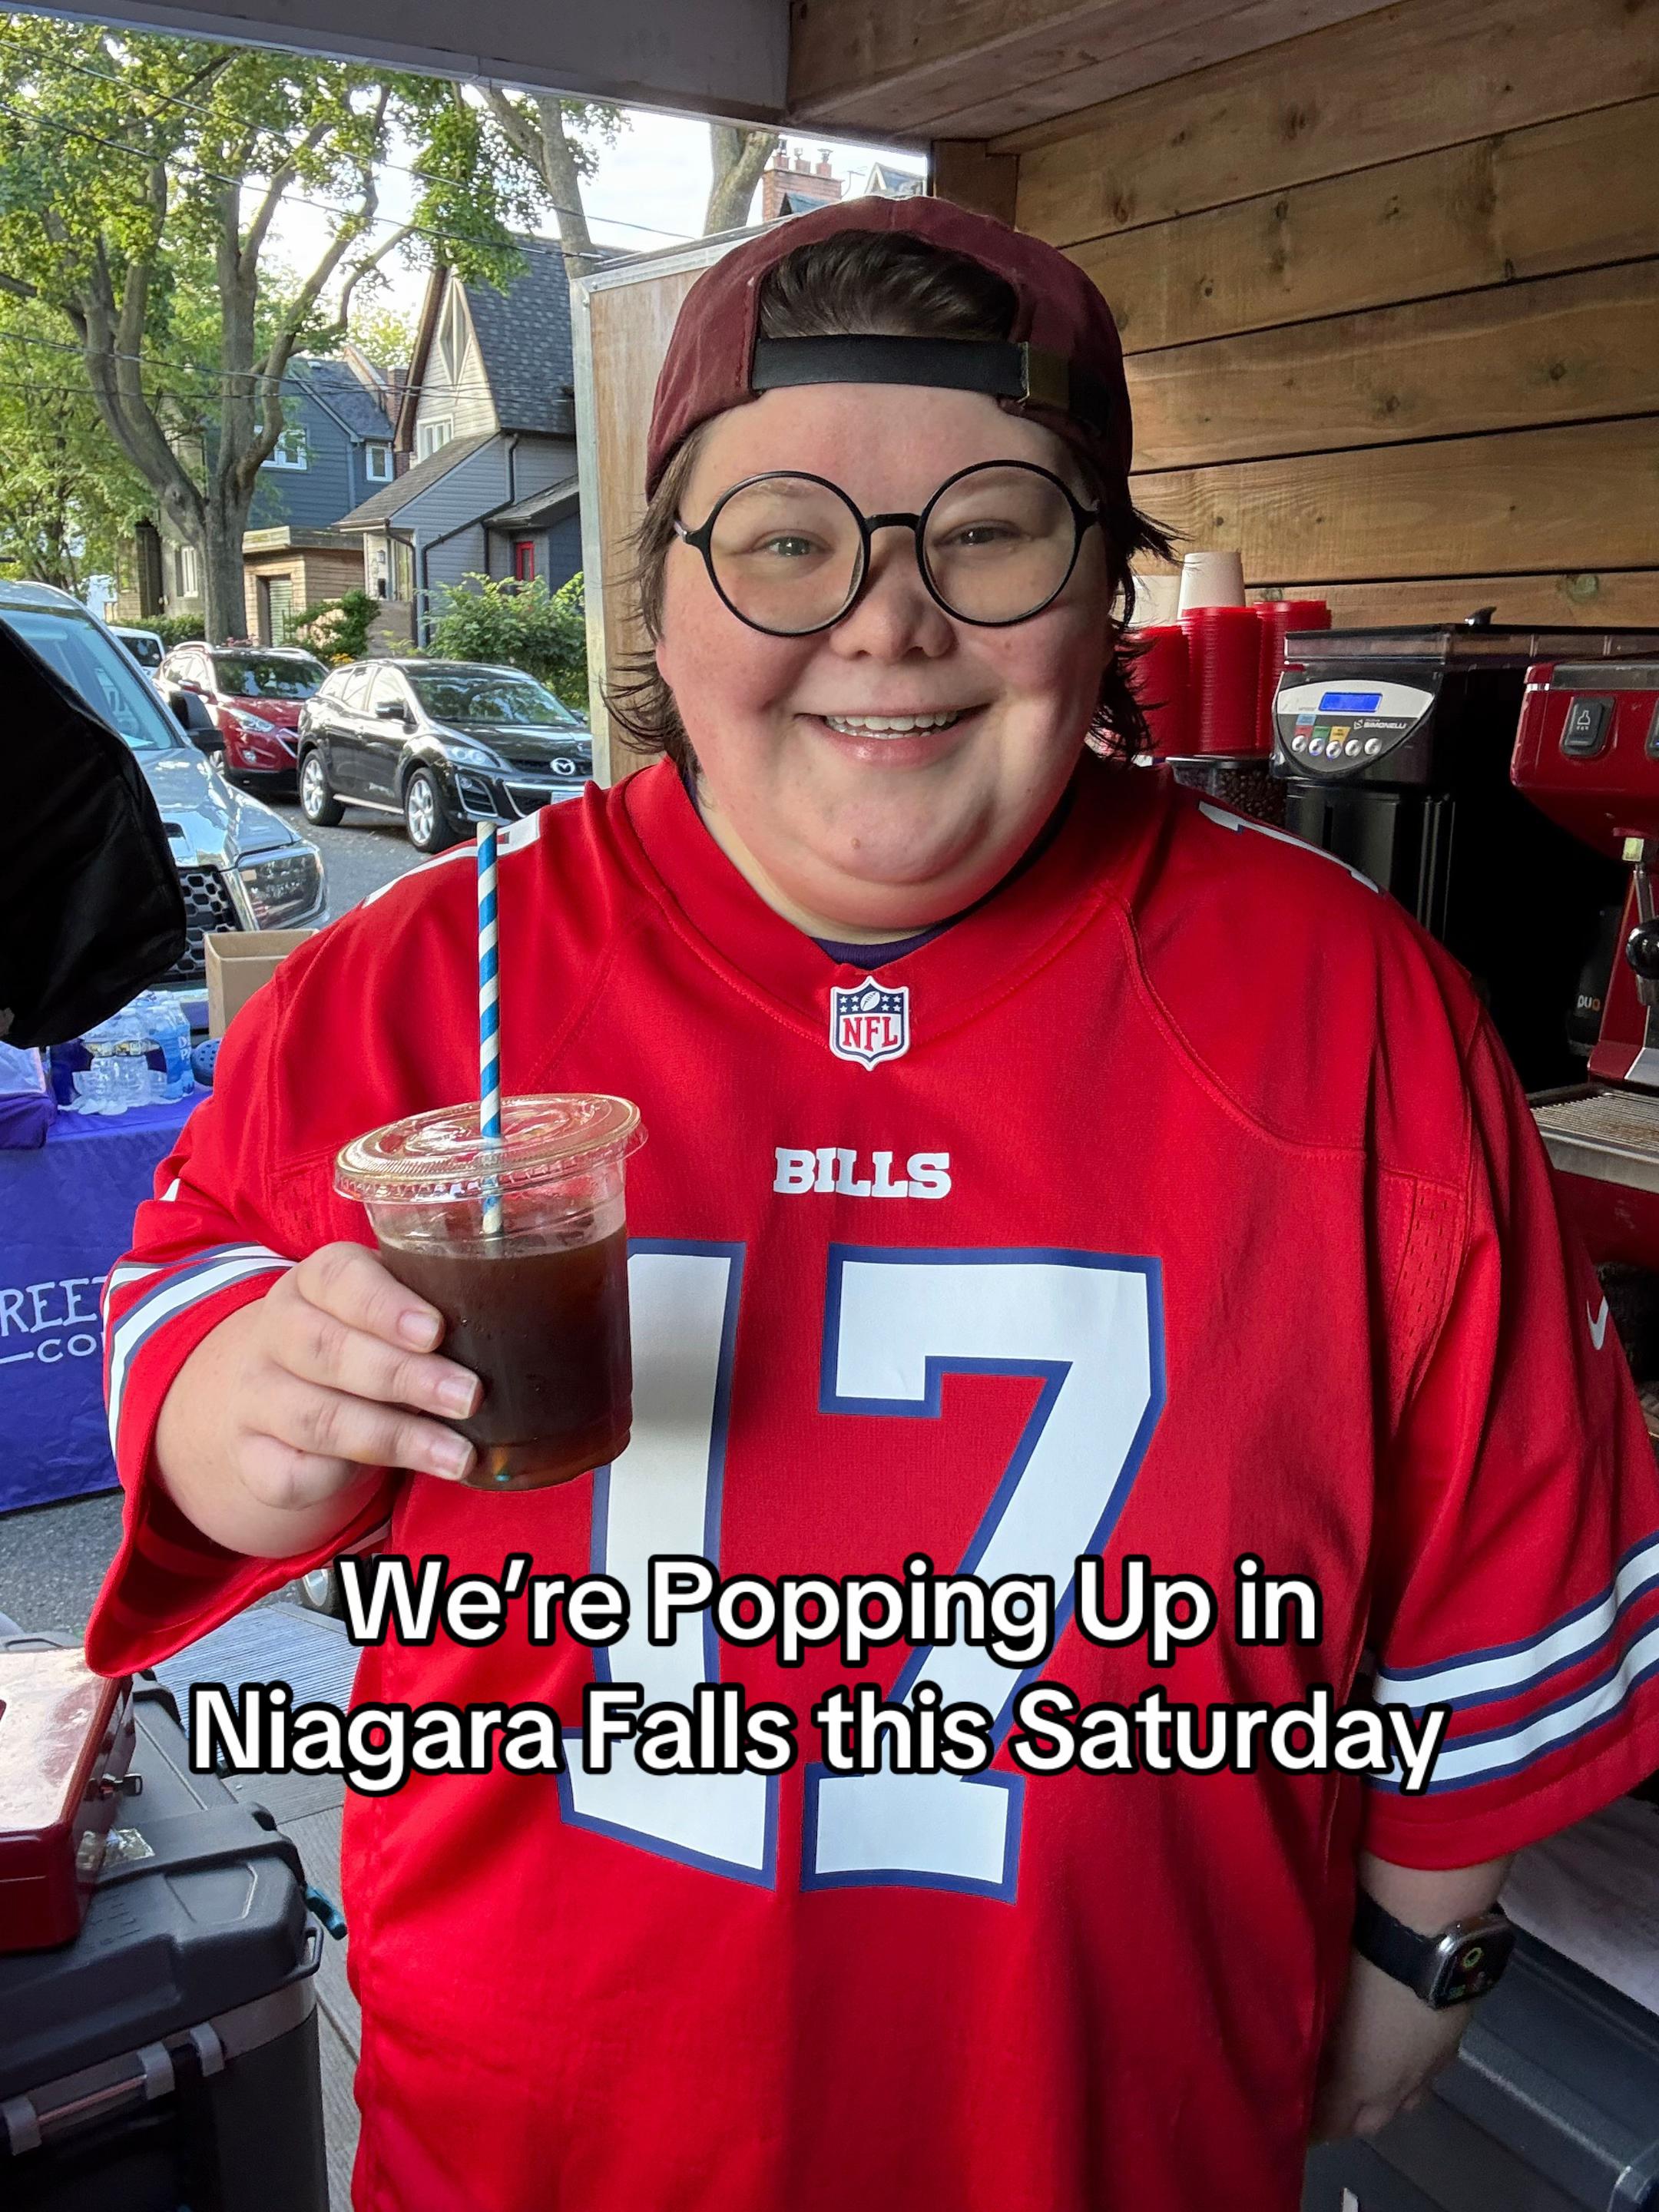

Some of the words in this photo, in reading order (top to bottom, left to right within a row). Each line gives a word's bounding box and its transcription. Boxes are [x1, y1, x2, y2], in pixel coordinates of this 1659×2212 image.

[843, 1016, 898, 1051] NFL
[773, 1147, 952, 1199] BILLS
[37, 1332, 104, 1363] CO
[560, 1238, 1167, 1904] 17
